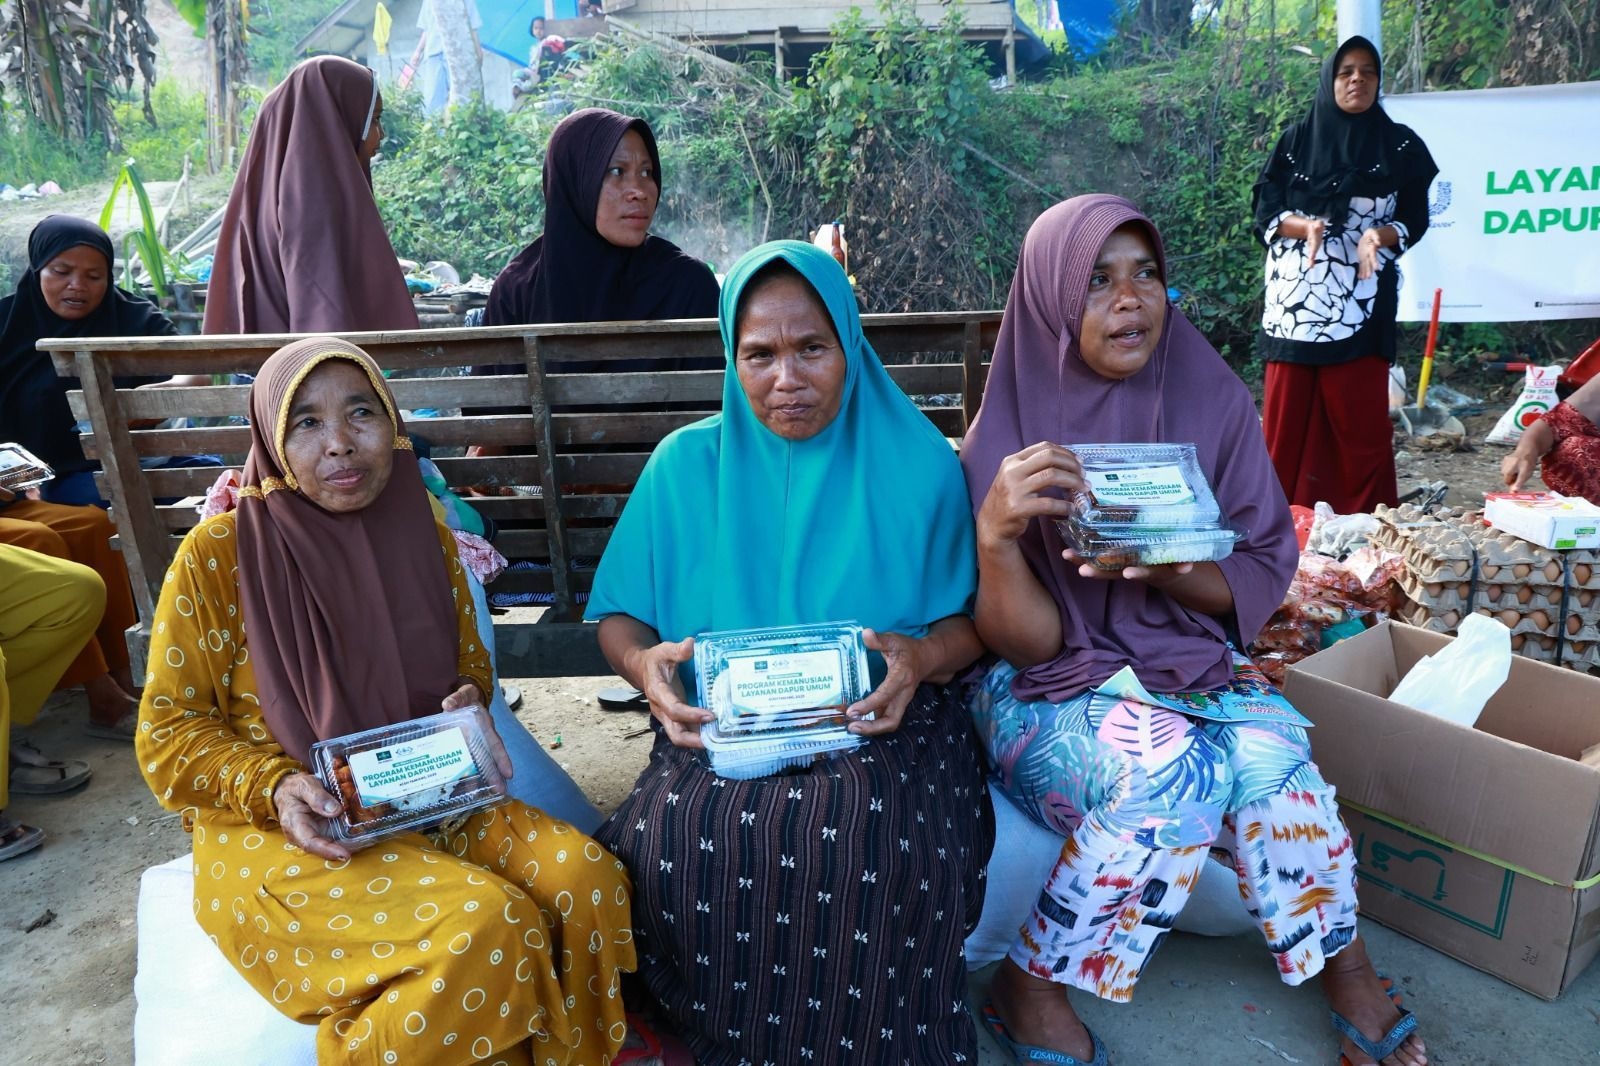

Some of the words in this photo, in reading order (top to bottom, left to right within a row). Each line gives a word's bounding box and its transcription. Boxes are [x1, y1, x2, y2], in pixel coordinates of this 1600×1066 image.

[737, 680, 776, 691] PROGRAM
[777, 675, 833, 687] KEMANUSIAAN
[741, 687, 777, 697] LAYANAN
[778, 685, 805, 694] DAPUR
[806, 682, 831, 692] UMUM
[362, 767, 404, 782] PROGRAM
[404, 749, 463, 772] KEMANUSIAAN
[368, 773, 407, 788] LAYANAN
[407, 765, 435, 780] DAPUR
[437, 756, 462, 769] UMUM
